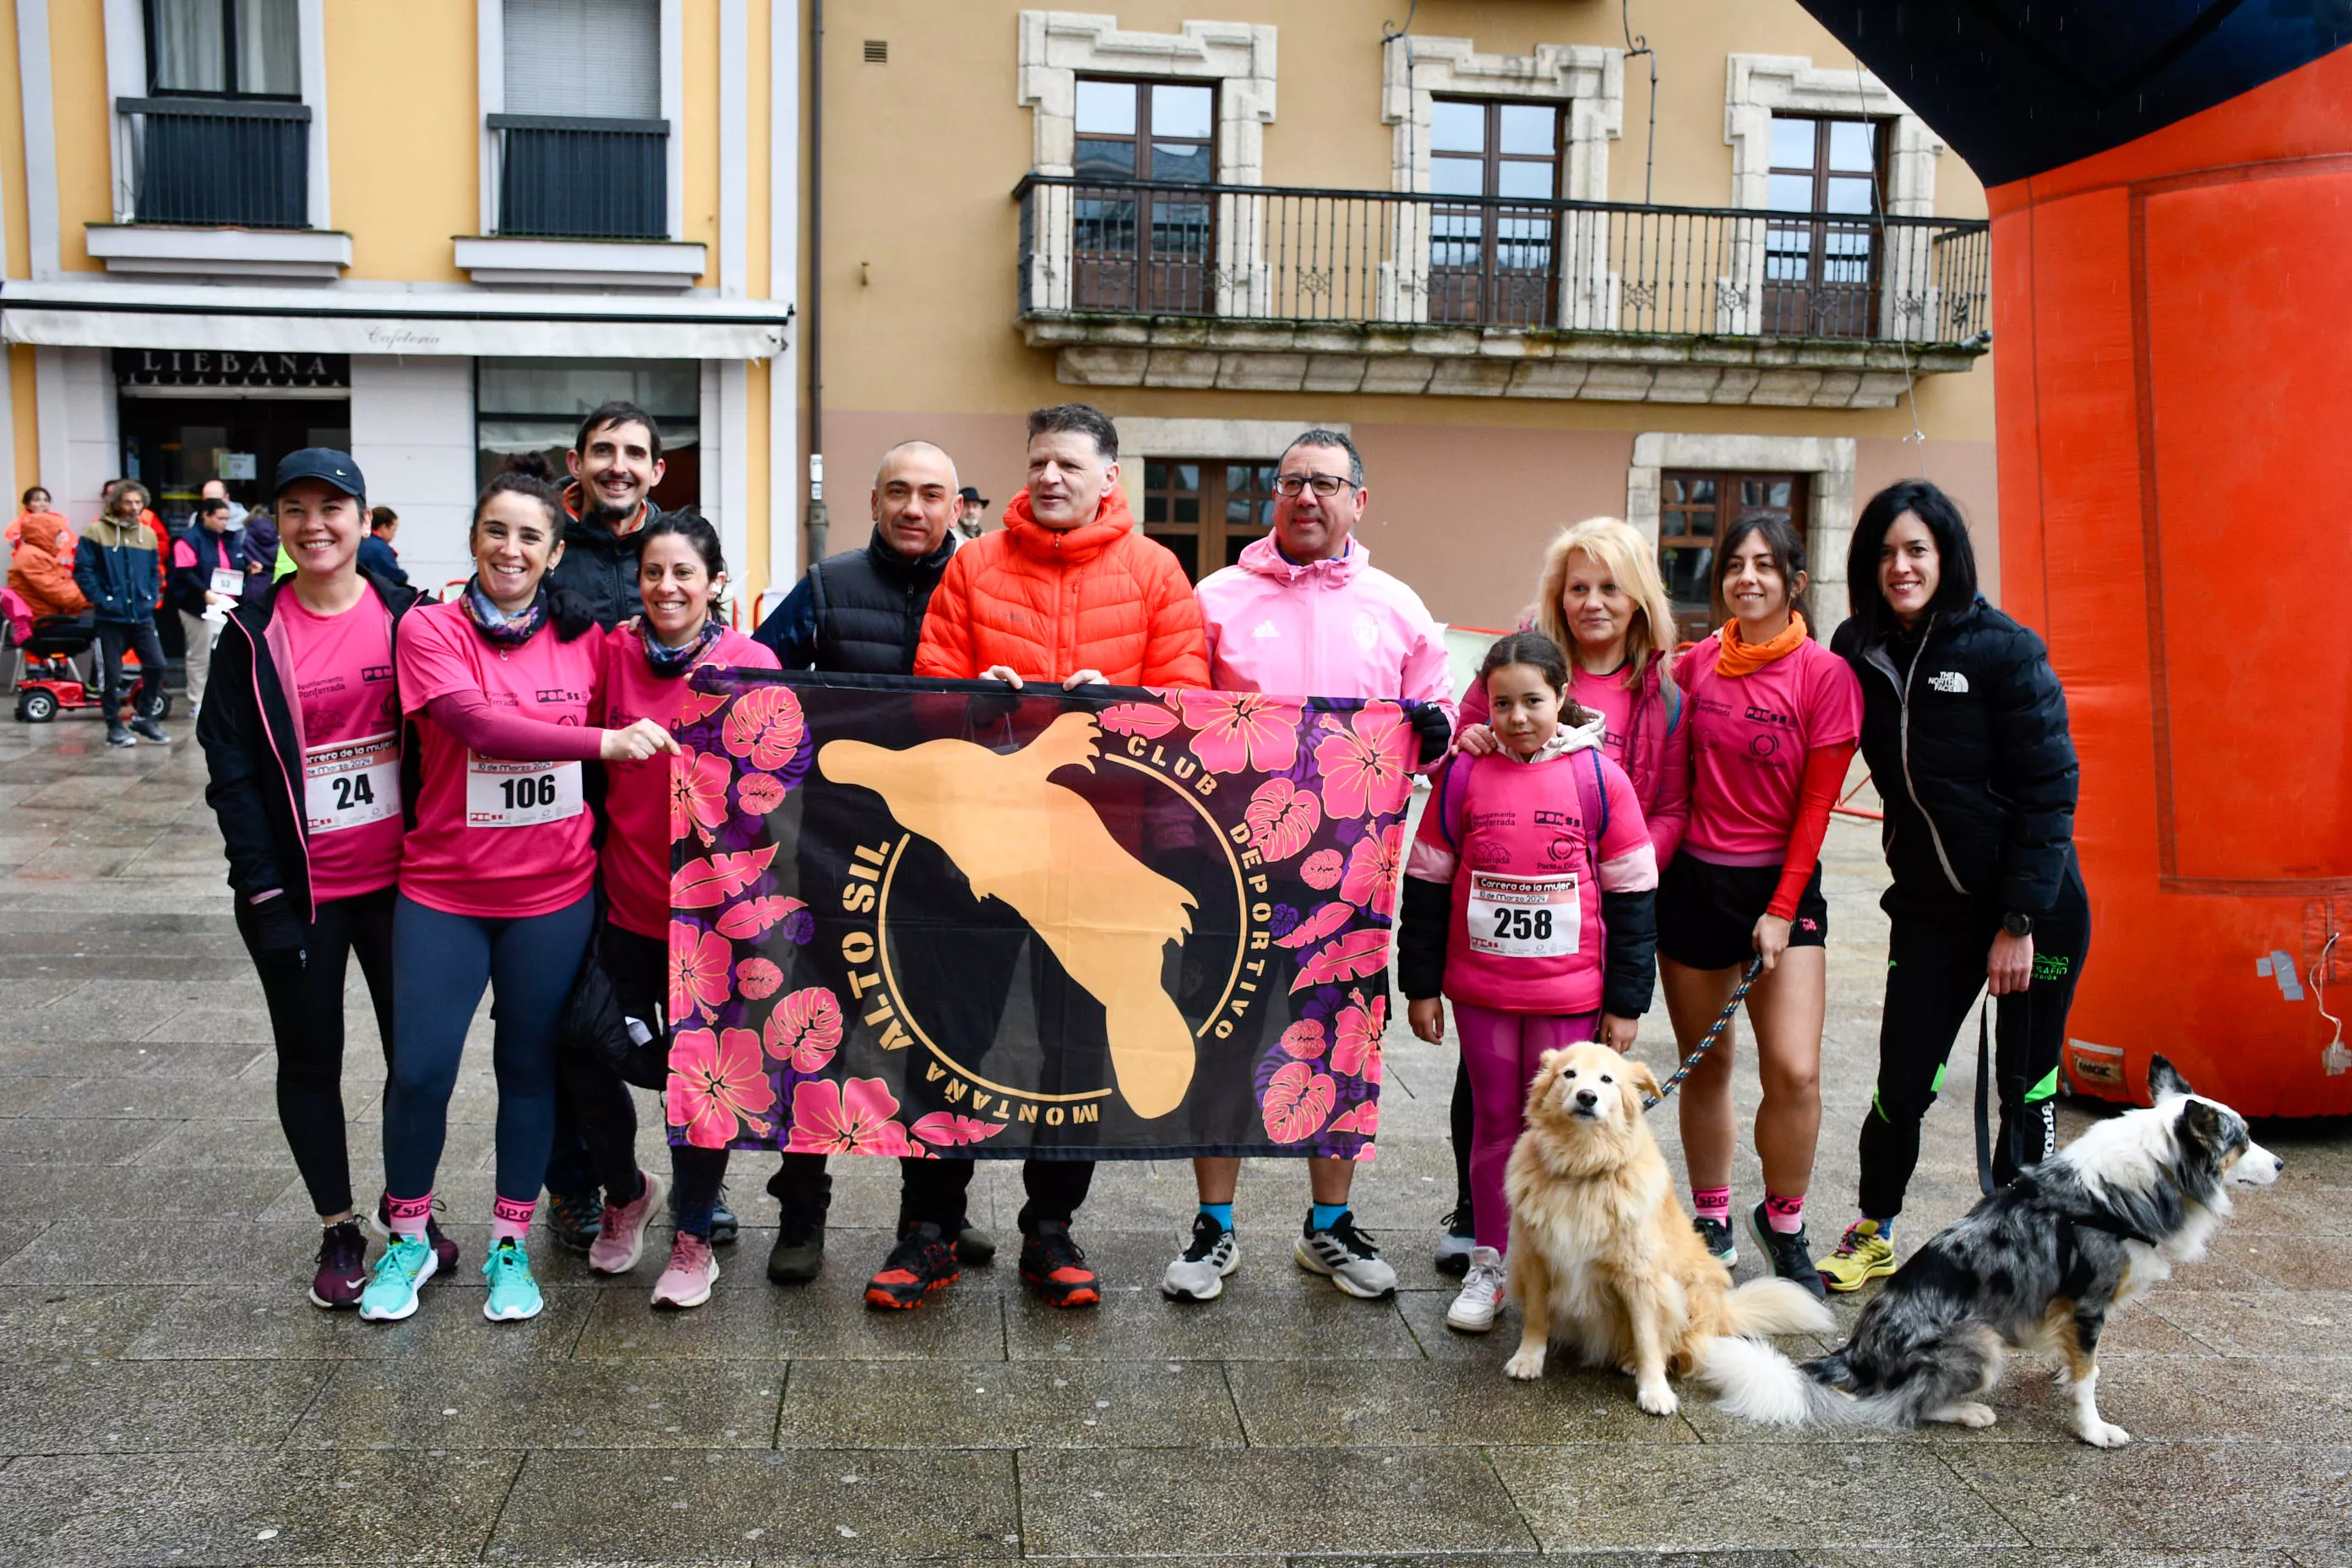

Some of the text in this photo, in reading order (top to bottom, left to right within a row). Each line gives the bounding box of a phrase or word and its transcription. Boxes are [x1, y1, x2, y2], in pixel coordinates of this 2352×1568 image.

[144, 351, 327, 375] LIEBANA
[366, 740, 394, 754] mujer
[332, 773, 374, 810] 24
[499, 774, 555, 808] 106
[1480, 879, 1571, 893] Carrera de la mujer
[1486, 891, 1494, 900] de
[841, 735, 1274, 1124] CLUB DEPORTIVO MONTAÑA ALTO SIL
[1494, 907, 1552, 940] 258
